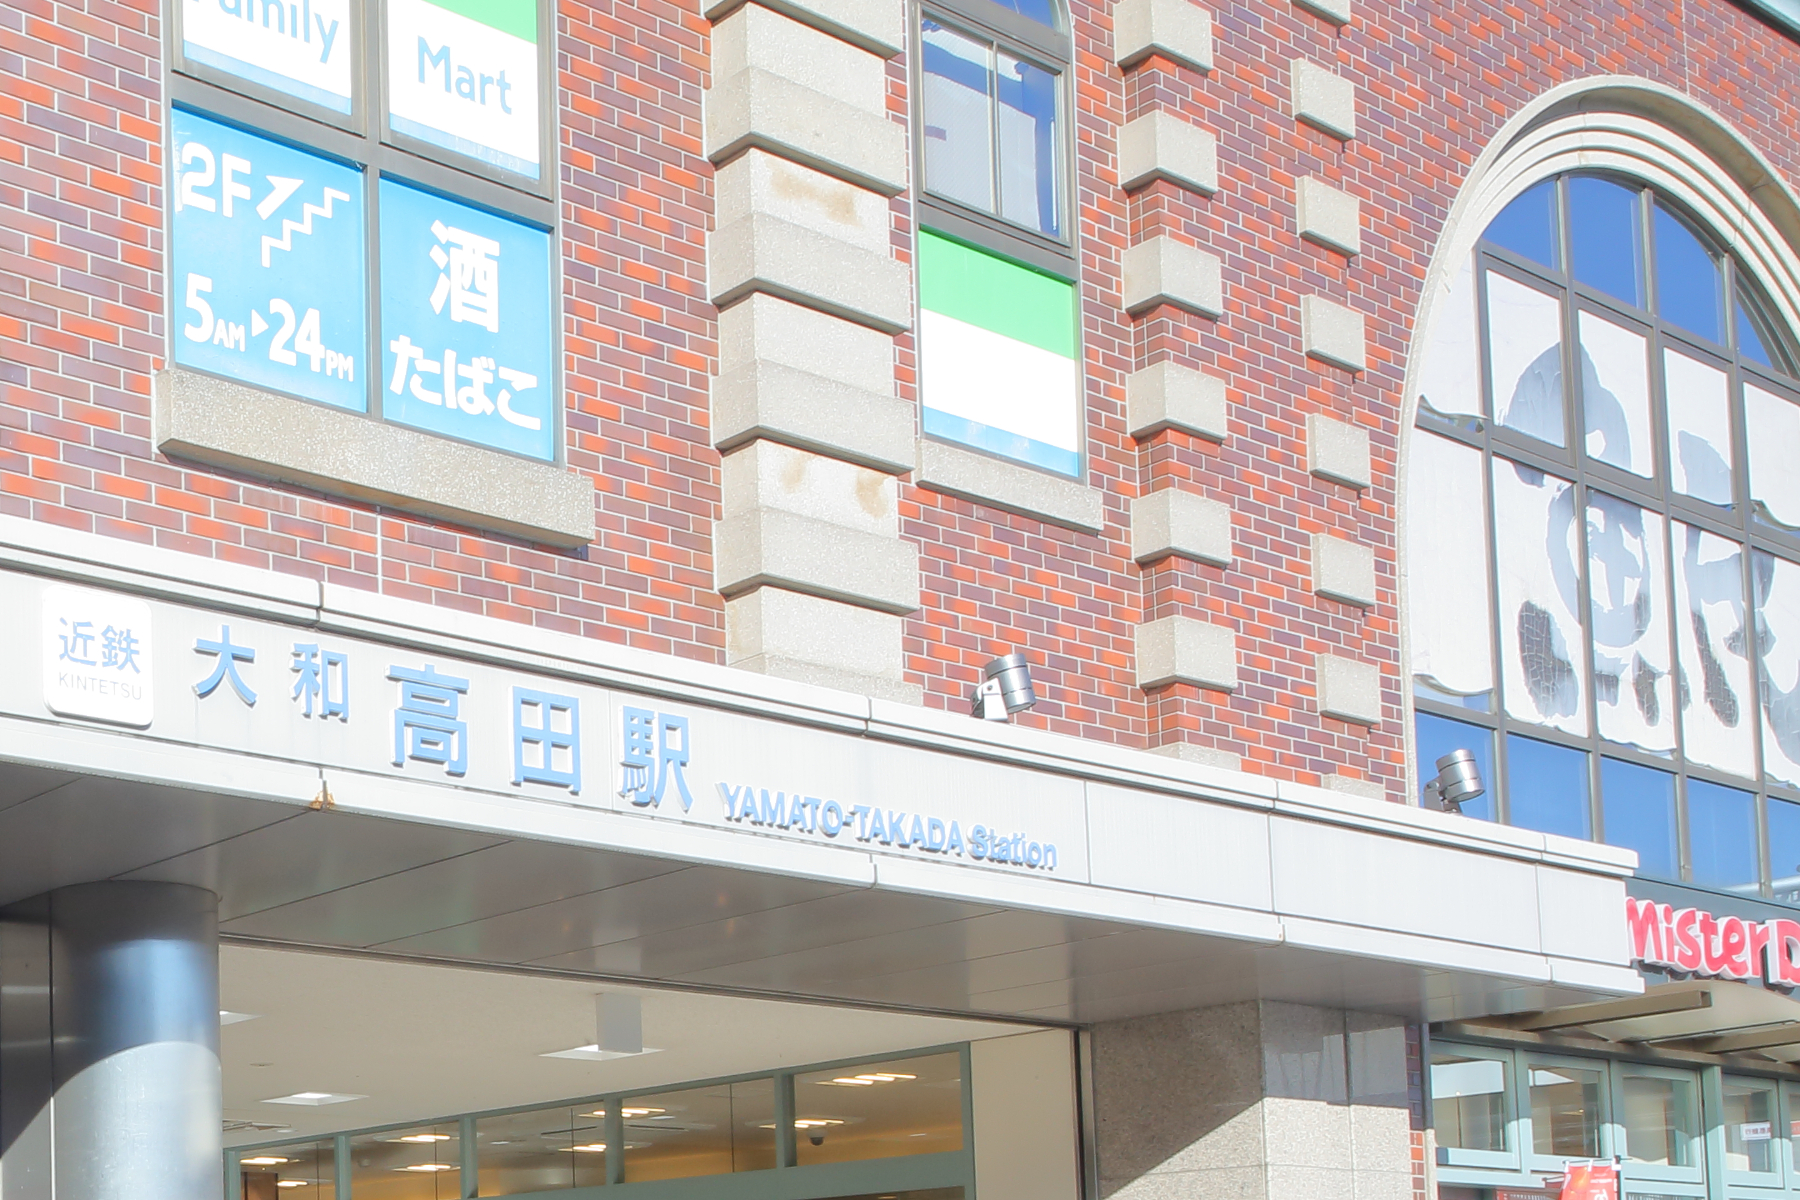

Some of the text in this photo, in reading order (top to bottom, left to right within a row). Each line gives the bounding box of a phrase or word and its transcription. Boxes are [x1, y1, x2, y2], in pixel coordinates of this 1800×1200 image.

[189, 0, 512, 115] amily Mart
[181, 141, 251, 218] 2F
[428, 219, 500, 334] 酒
[390, 334, 541, 431] たばこ
[58, 616, 141, 674] 近鉄
[58, 671, 142, 700] KINTETSU
[192, 624, 693, 812] 大和高田駅
[716, 781, 1058, 871] YAMATO-TAKADA Station
